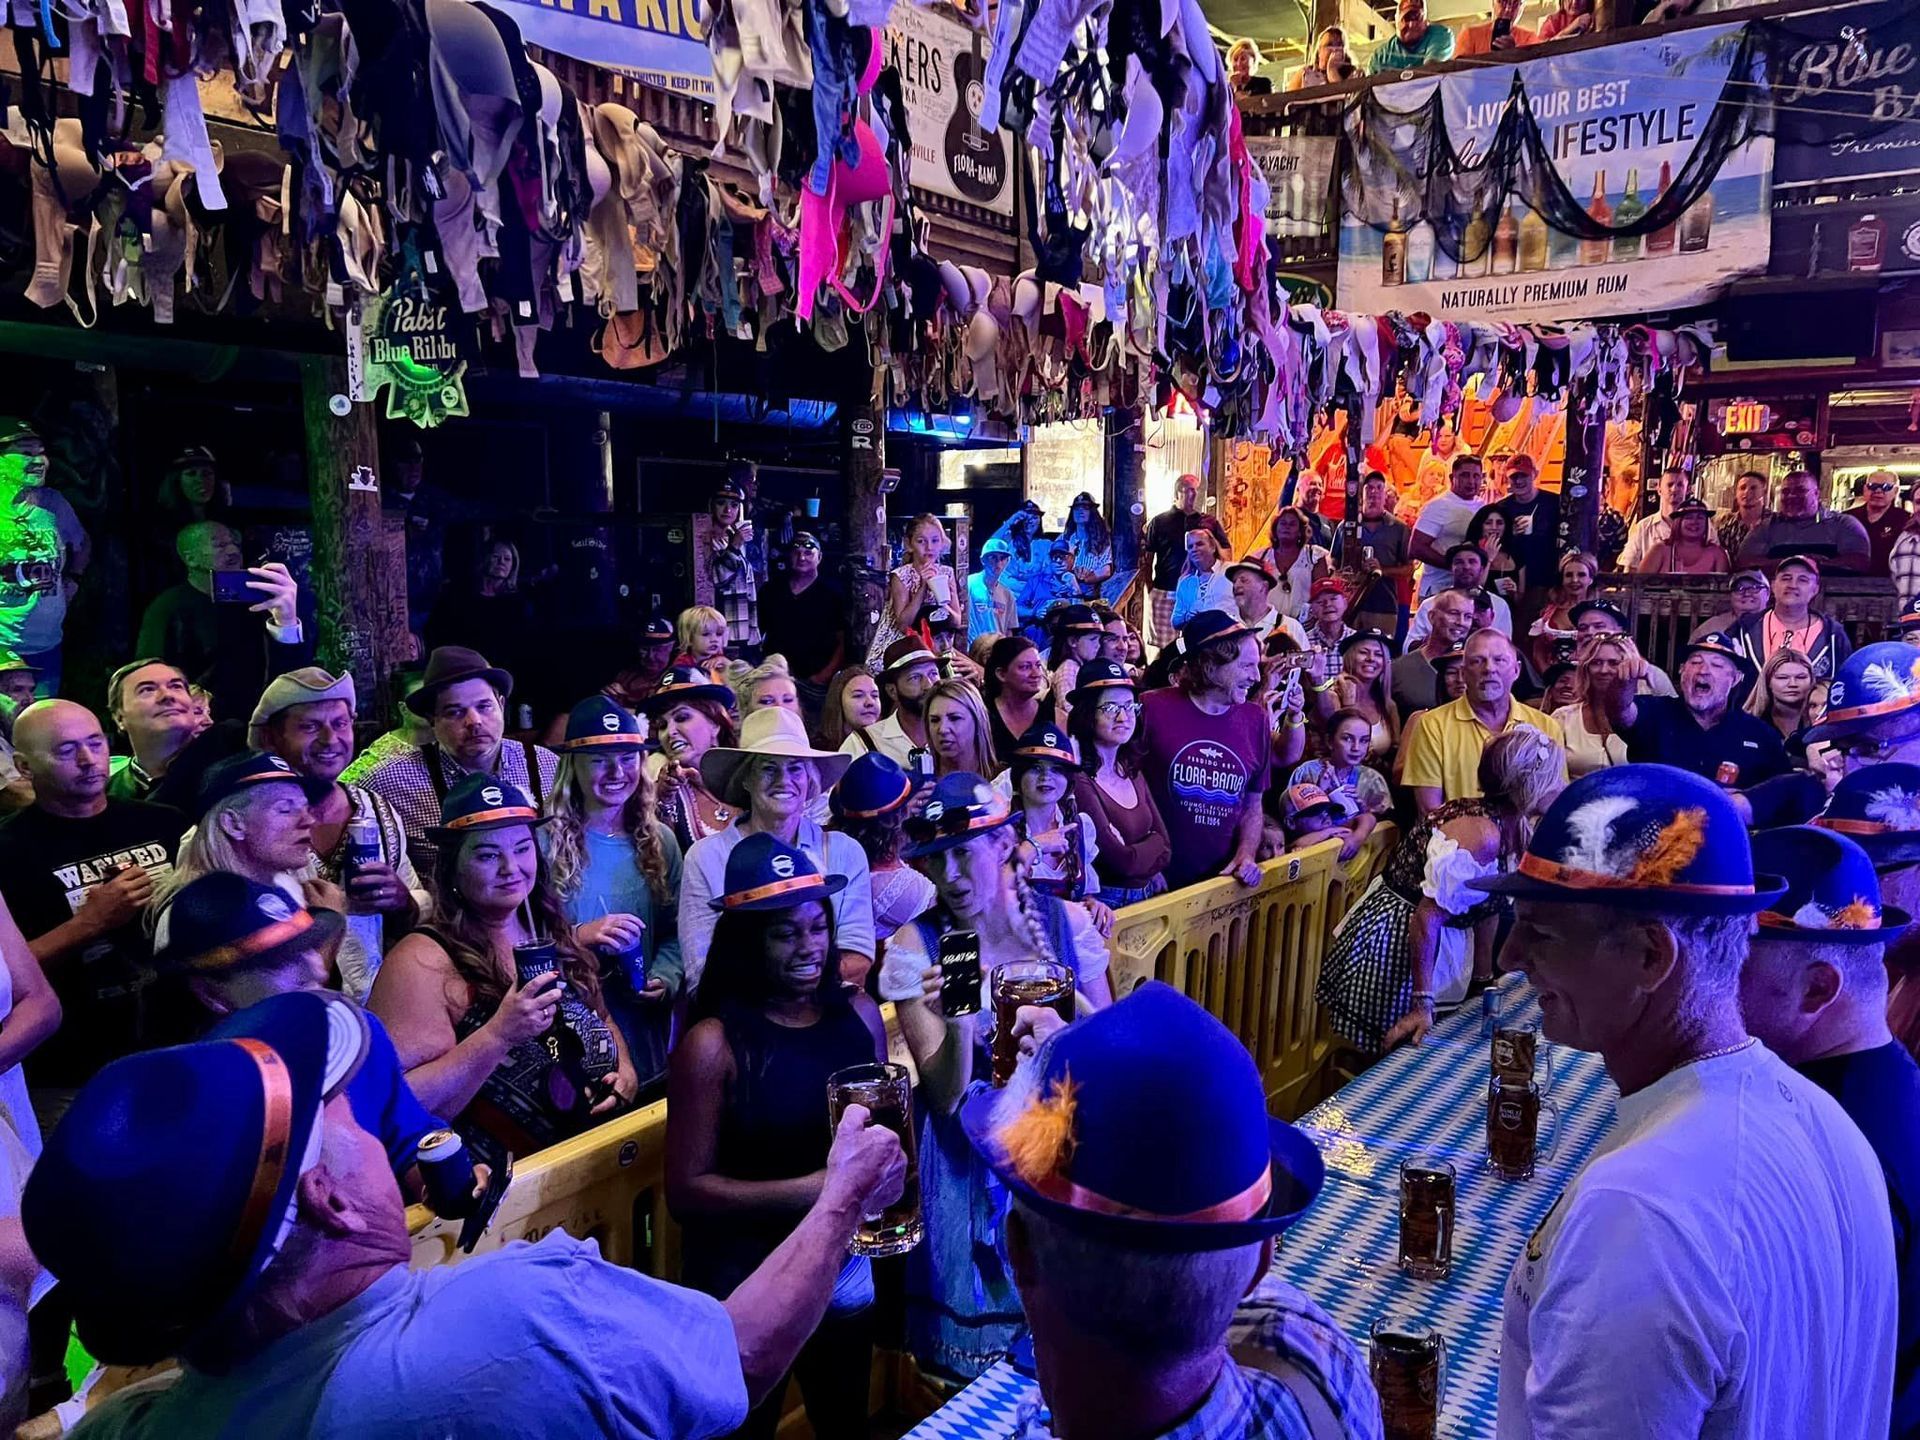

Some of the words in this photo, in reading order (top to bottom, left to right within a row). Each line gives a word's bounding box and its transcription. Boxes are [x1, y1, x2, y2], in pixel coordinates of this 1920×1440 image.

[882, 26, 942, 94] KERS
[1781, 42, 1917, 103] Blue
[671, 75, 690, 90] KEEP
[1576, 79, 1631, 113] BEST
[953, 153, 1000, 186] FLORA-BAMA
[1267, 155, 1300, 171] YACHT
[1440, 286, 1518, 309] NATURALLY
[1523, 278, 1588, 302] PREMIUM
[1596, 274, 1628, 296] RUM
[392, 296, 447, 333] Pabst
[374, 338, 411, 363] Blue
[1725, 404, 1765, 433] EXIT
[1173, 763, 1244, 791] FLORA-BAMA
